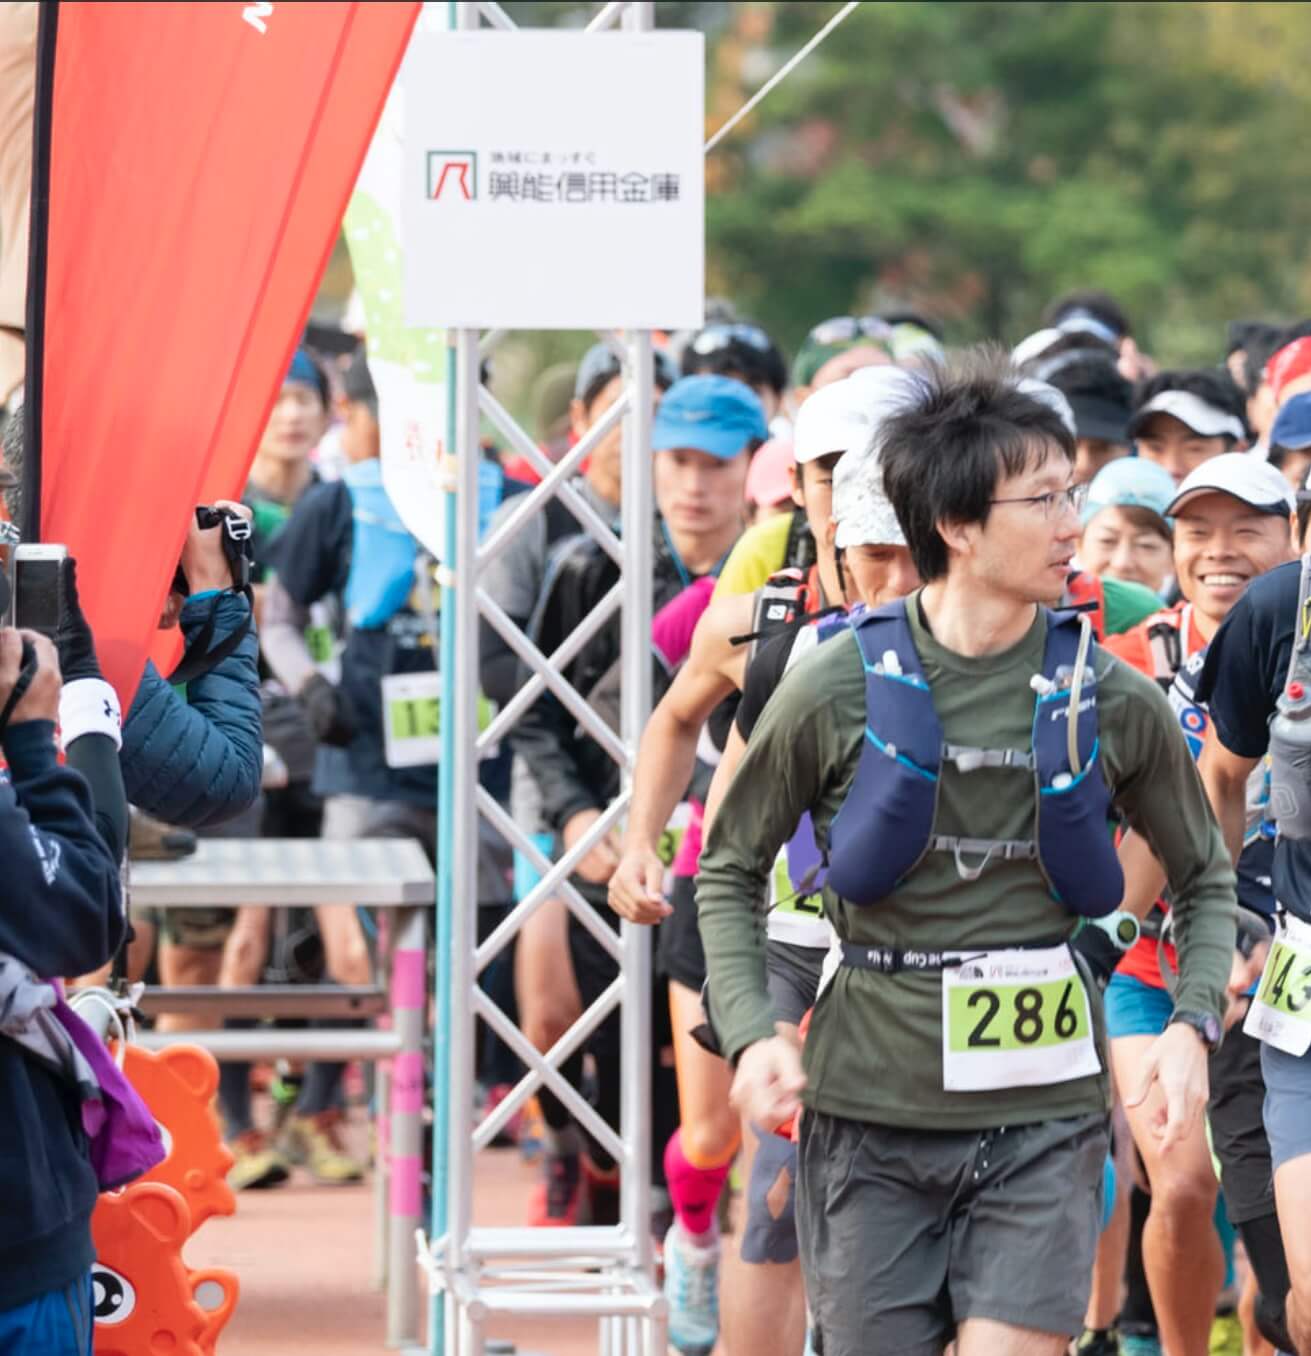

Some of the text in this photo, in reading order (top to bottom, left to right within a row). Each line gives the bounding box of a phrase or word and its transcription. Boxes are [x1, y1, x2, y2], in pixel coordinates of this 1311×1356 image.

[488, 170, 681, 203] 興能信用金庫
[967, 981, 1078, 1048] 286
